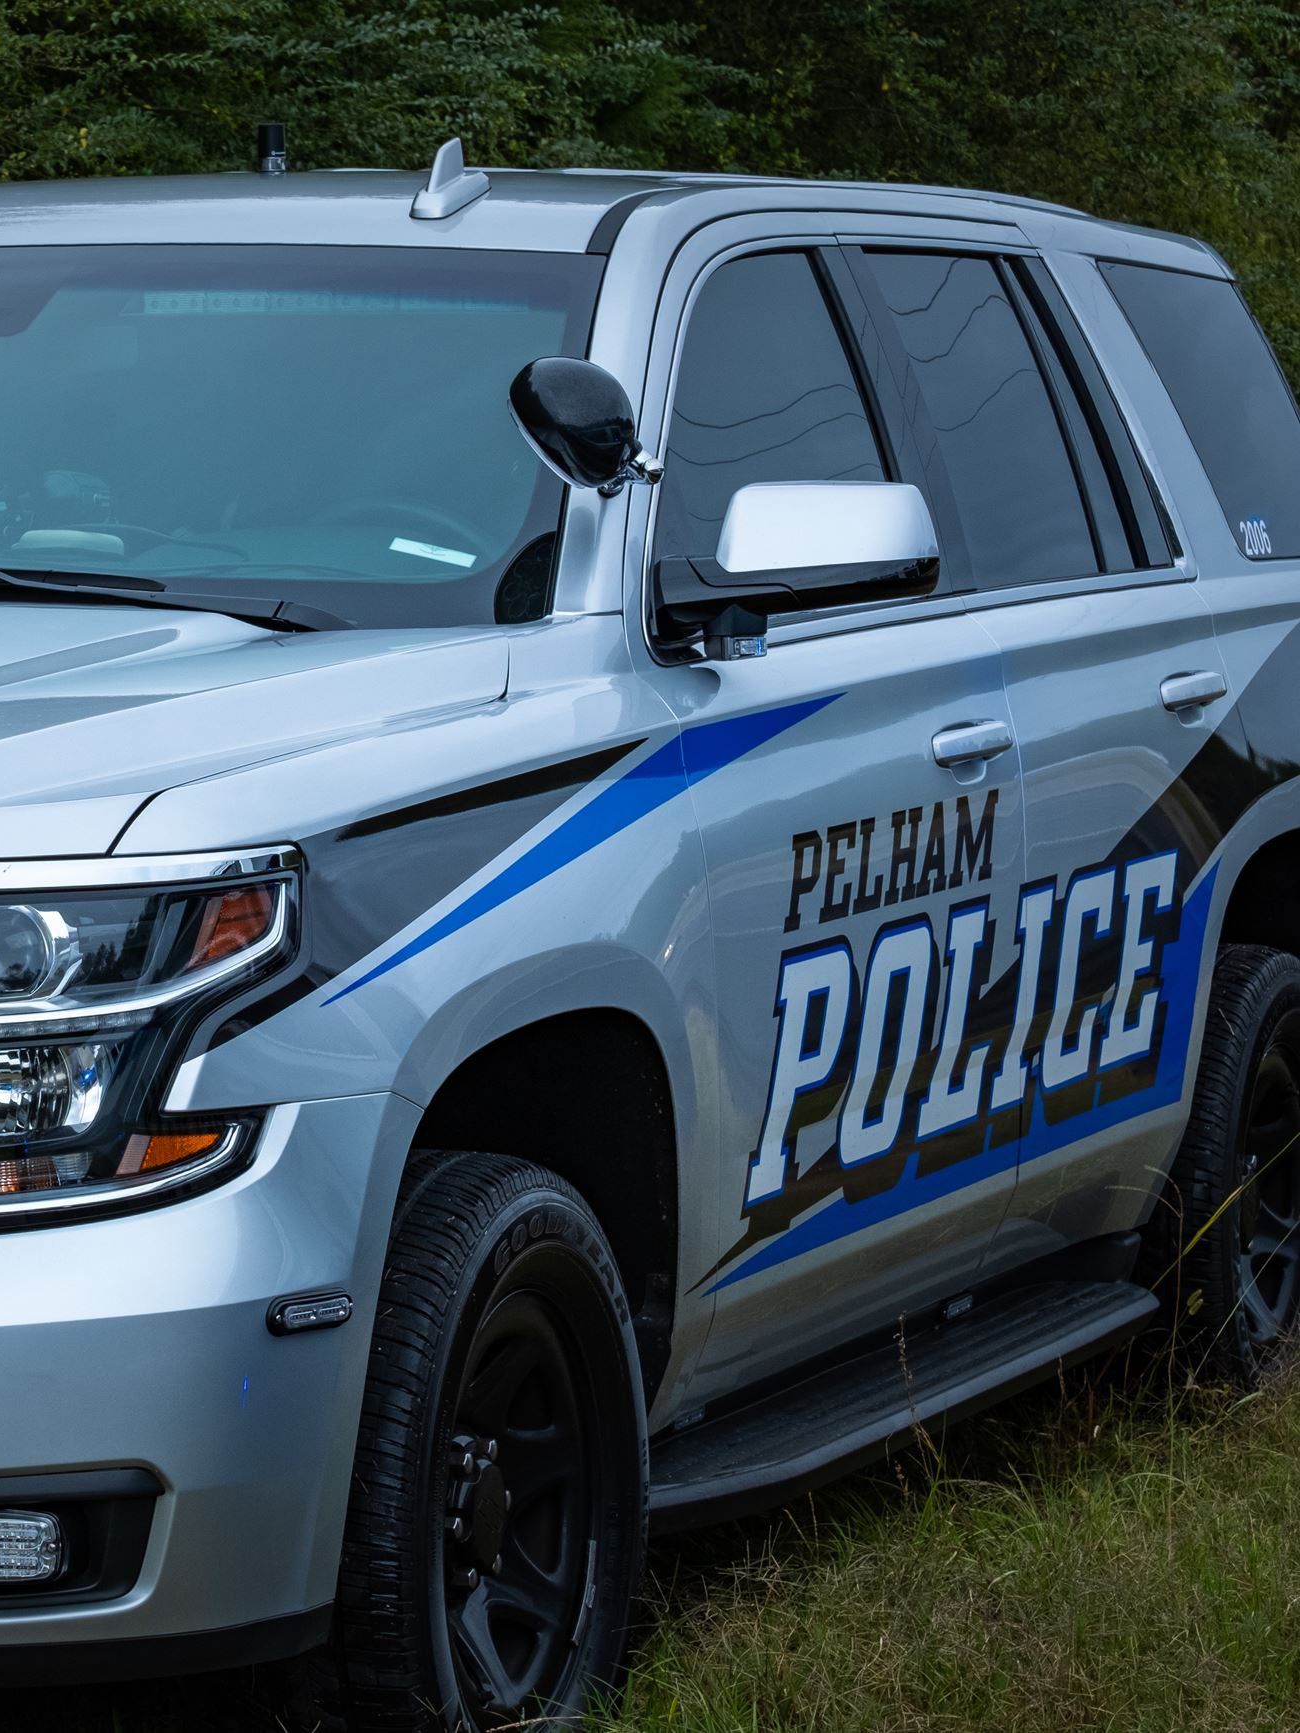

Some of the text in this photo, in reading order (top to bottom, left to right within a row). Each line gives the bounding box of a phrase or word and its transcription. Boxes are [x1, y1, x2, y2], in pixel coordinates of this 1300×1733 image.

[1239, 519, 1272, 556] 2006
[783, 788, 999, 933] PELHAM
[744, 848, 1179, 1208] POLICE
[493, 1211, 632, 1327] GOODYEAR
